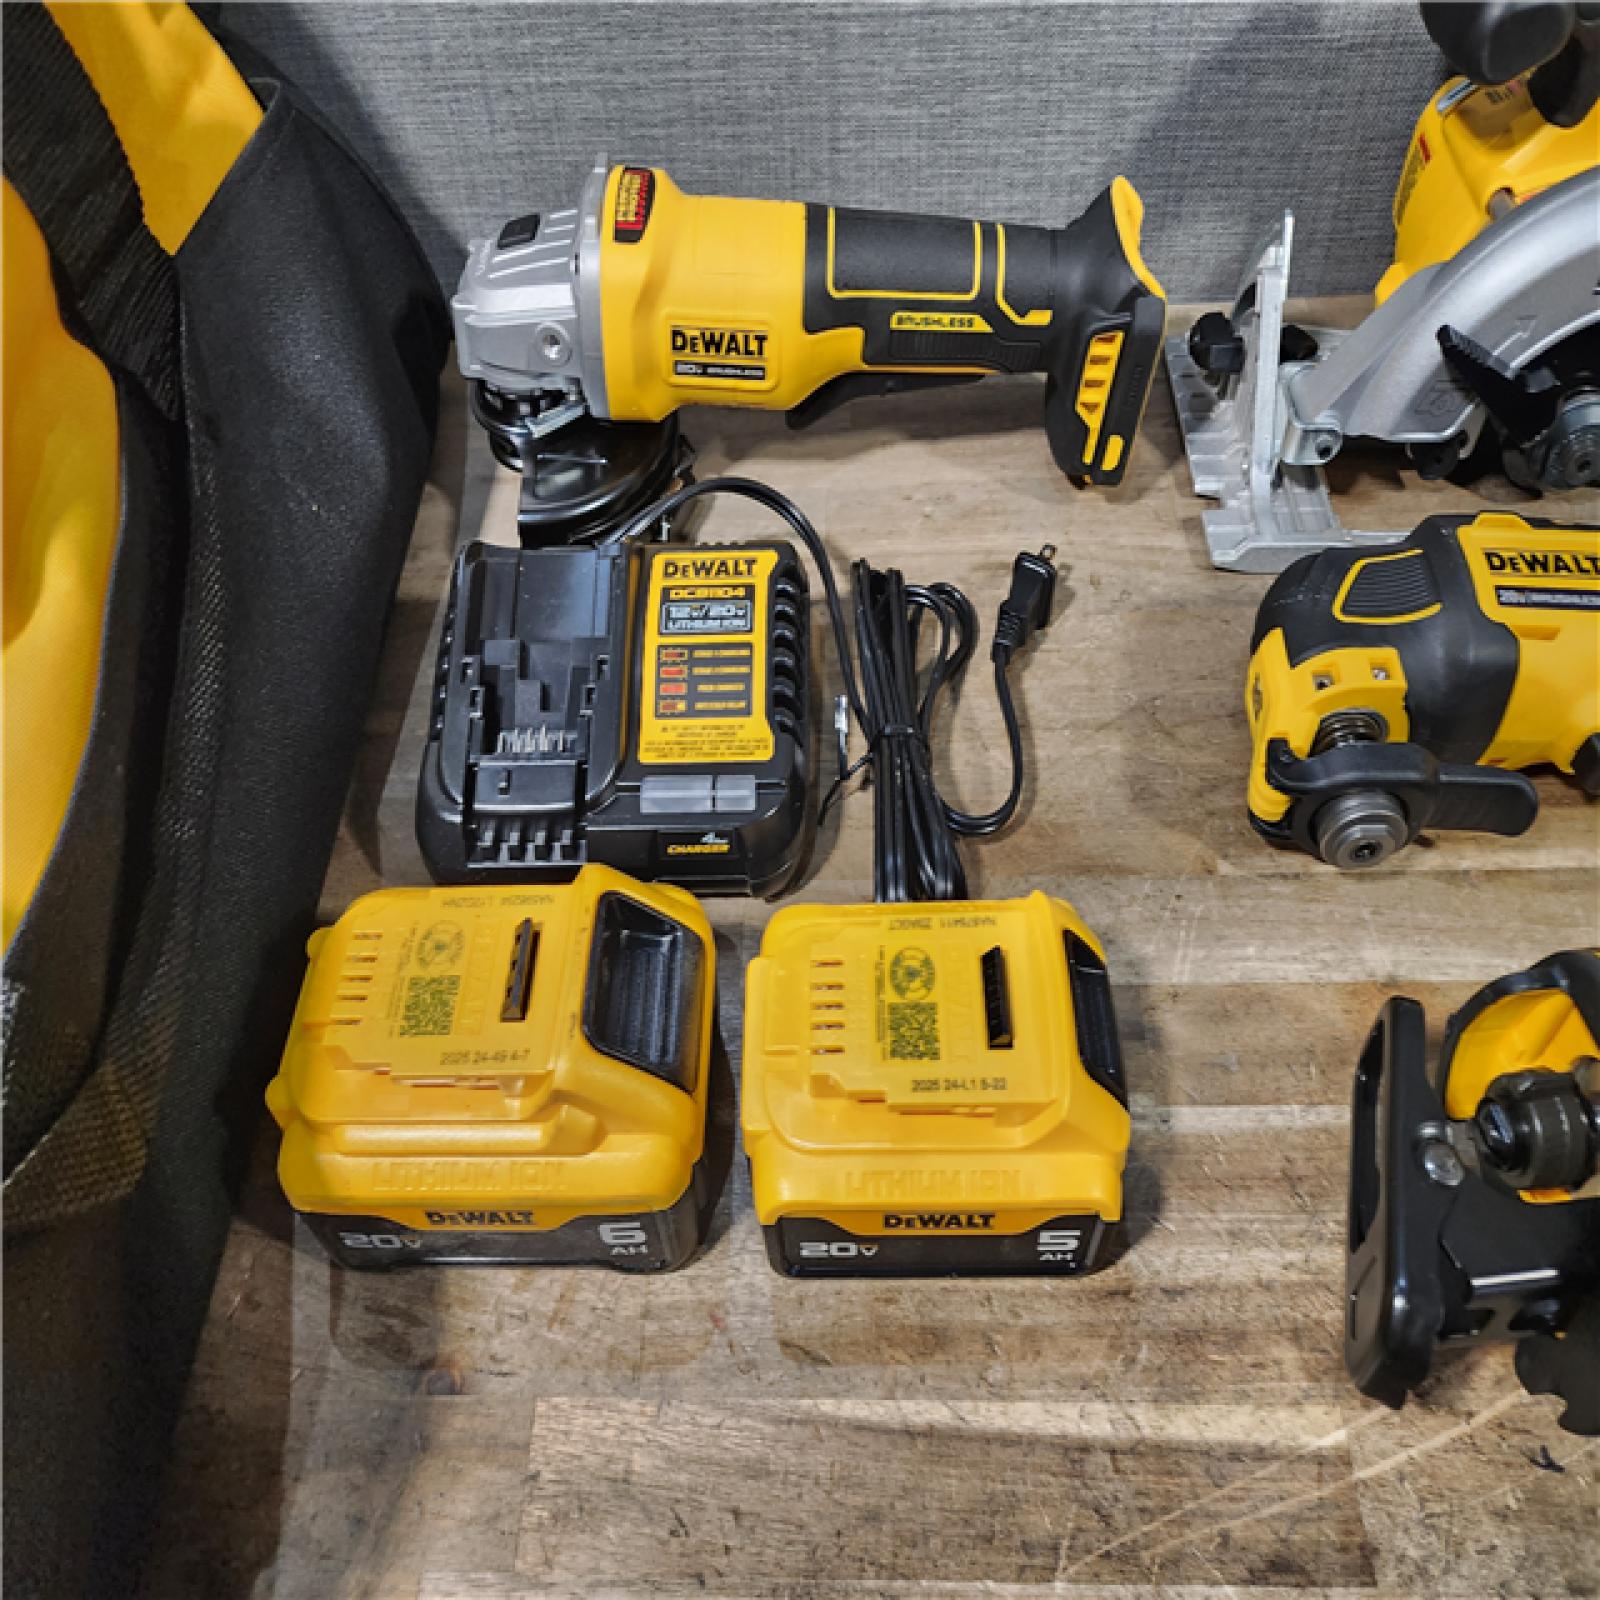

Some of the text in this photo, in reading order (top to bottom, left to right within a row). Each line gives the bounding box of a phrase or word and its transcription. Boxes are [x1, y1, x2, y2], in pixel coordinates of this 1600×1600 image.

[671, 329, 769, 355] DEWALT
[664, 559, 758, 578] DEWALT
[424, 1210, 535, 1226] DEWALT
[883, 1213, 996, 1230] DEWALT
[598, 1222, 647, 1245] 6
[1036, 1229, 1081, 1251] 5
